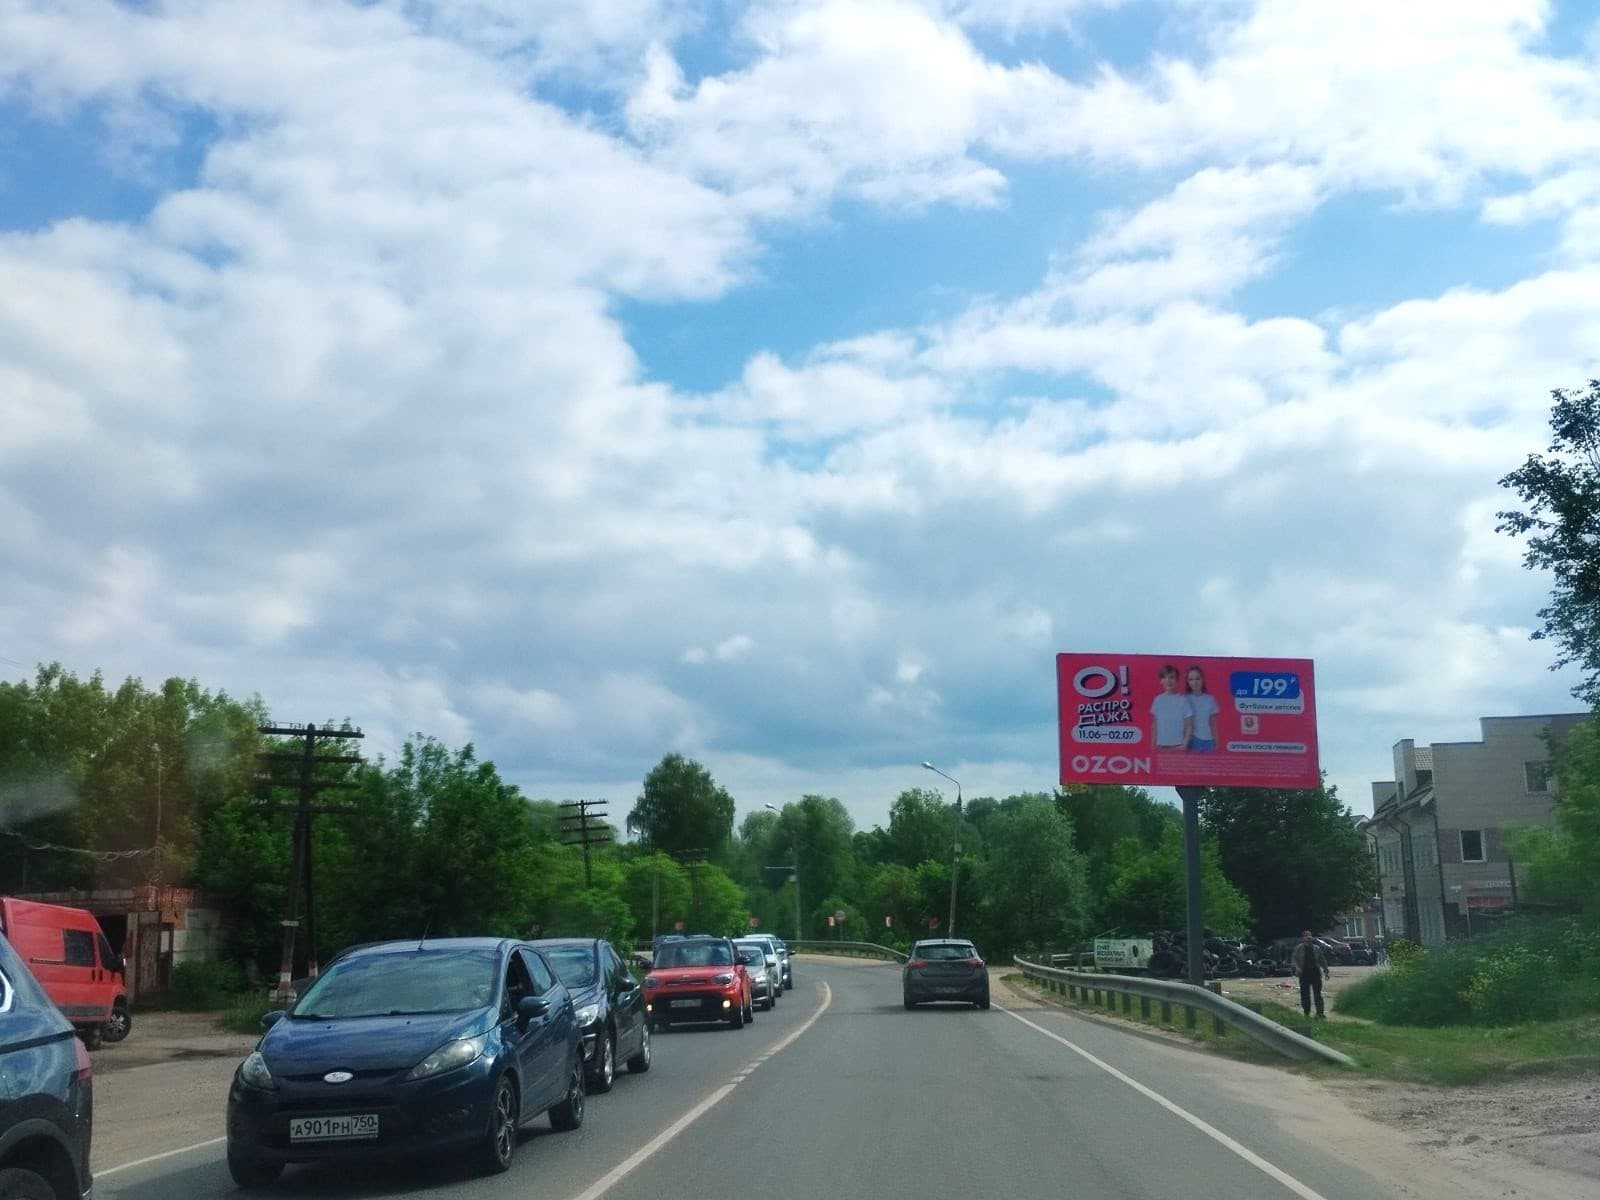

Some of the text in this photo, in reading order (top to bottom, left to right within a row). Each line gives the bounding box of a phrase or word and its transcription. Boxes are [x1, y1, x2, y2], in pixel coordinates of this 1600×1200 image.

[1252, 678, 1287, 696] 199
[1078, 699, 1130, 714] РАСПРО
[1078, 711, 1130, 727] ДАЖА
[1071, 754, 1152, 775] OZON
[352, 1115, 375, 1129] 750
